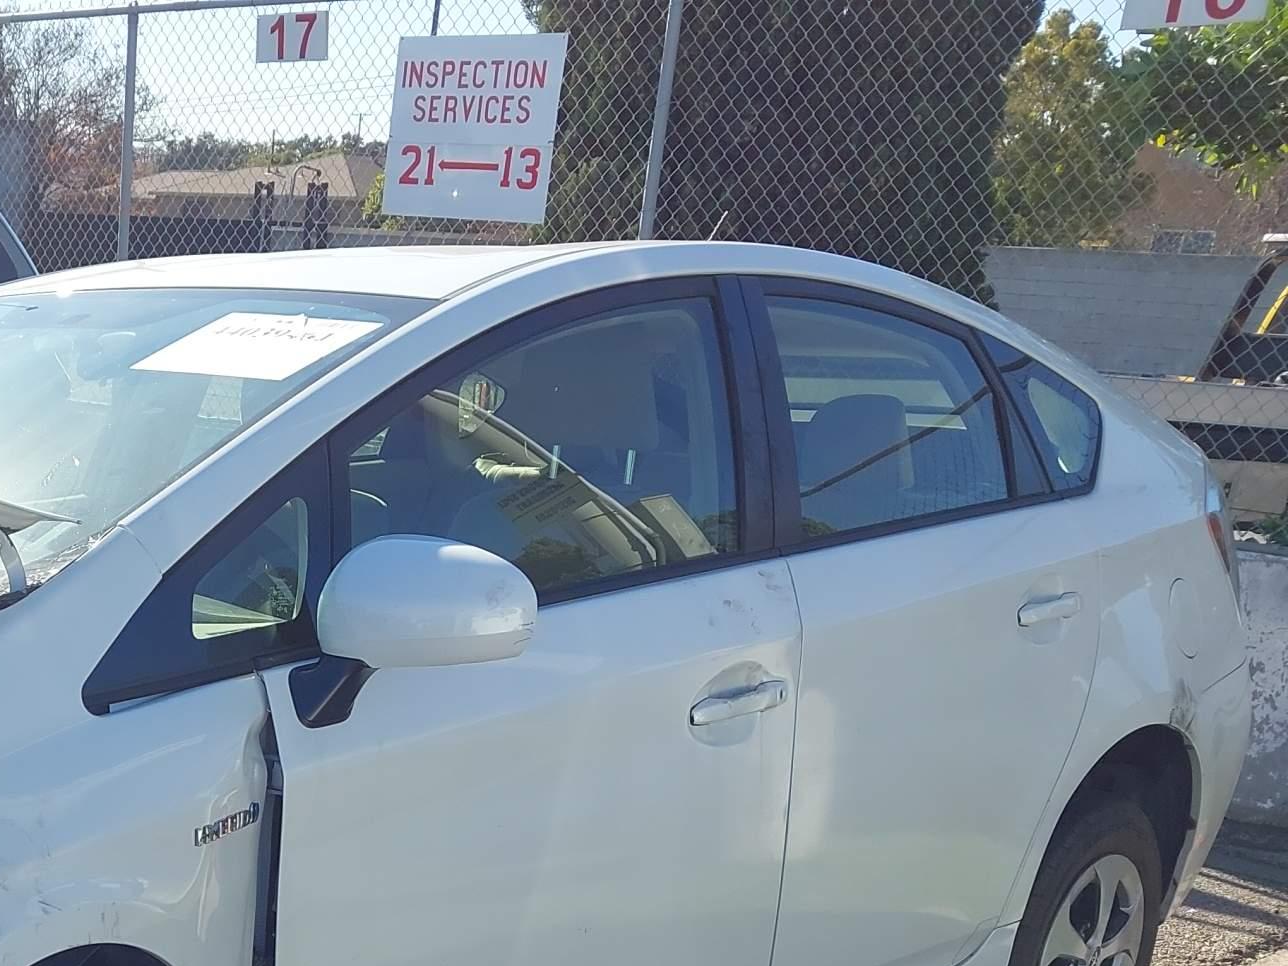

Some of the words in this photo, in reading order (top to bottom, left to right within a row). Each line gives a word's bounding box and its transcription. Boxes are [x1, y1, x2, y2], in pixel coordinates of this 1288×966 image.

[270, 13, 318, 60] 17
[401, 59, 548, 89] INSPECTION
[412, 95, 532, 124] SERVICES
[398, 144, 436, 186] 21
[499, 146, 542, 190] 13
